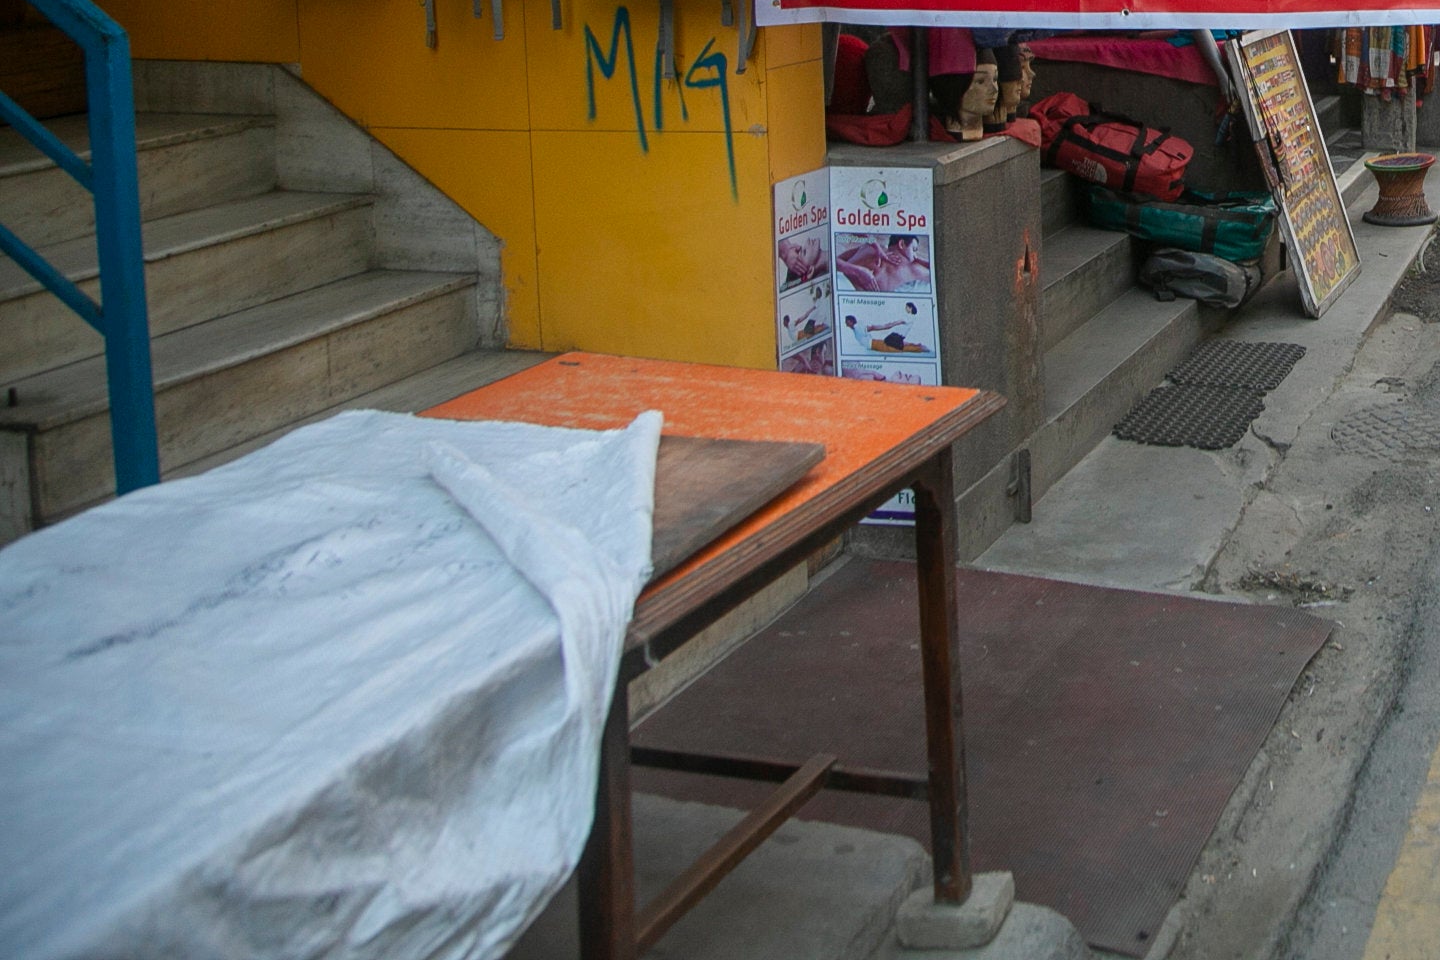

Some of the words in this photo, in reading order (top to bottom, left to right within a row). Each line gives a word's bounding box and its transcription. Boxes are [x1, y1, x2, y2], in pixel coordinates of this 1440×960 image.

[779, 211, 809, 235] Golden
[810, 205, 828, 226] Spa
[837, 208, 890, 228] Golden
[896, 209, 927, 231] Spa
[856, 298, 886, 307] Massage
[857, 362, 883, 371] Massage
